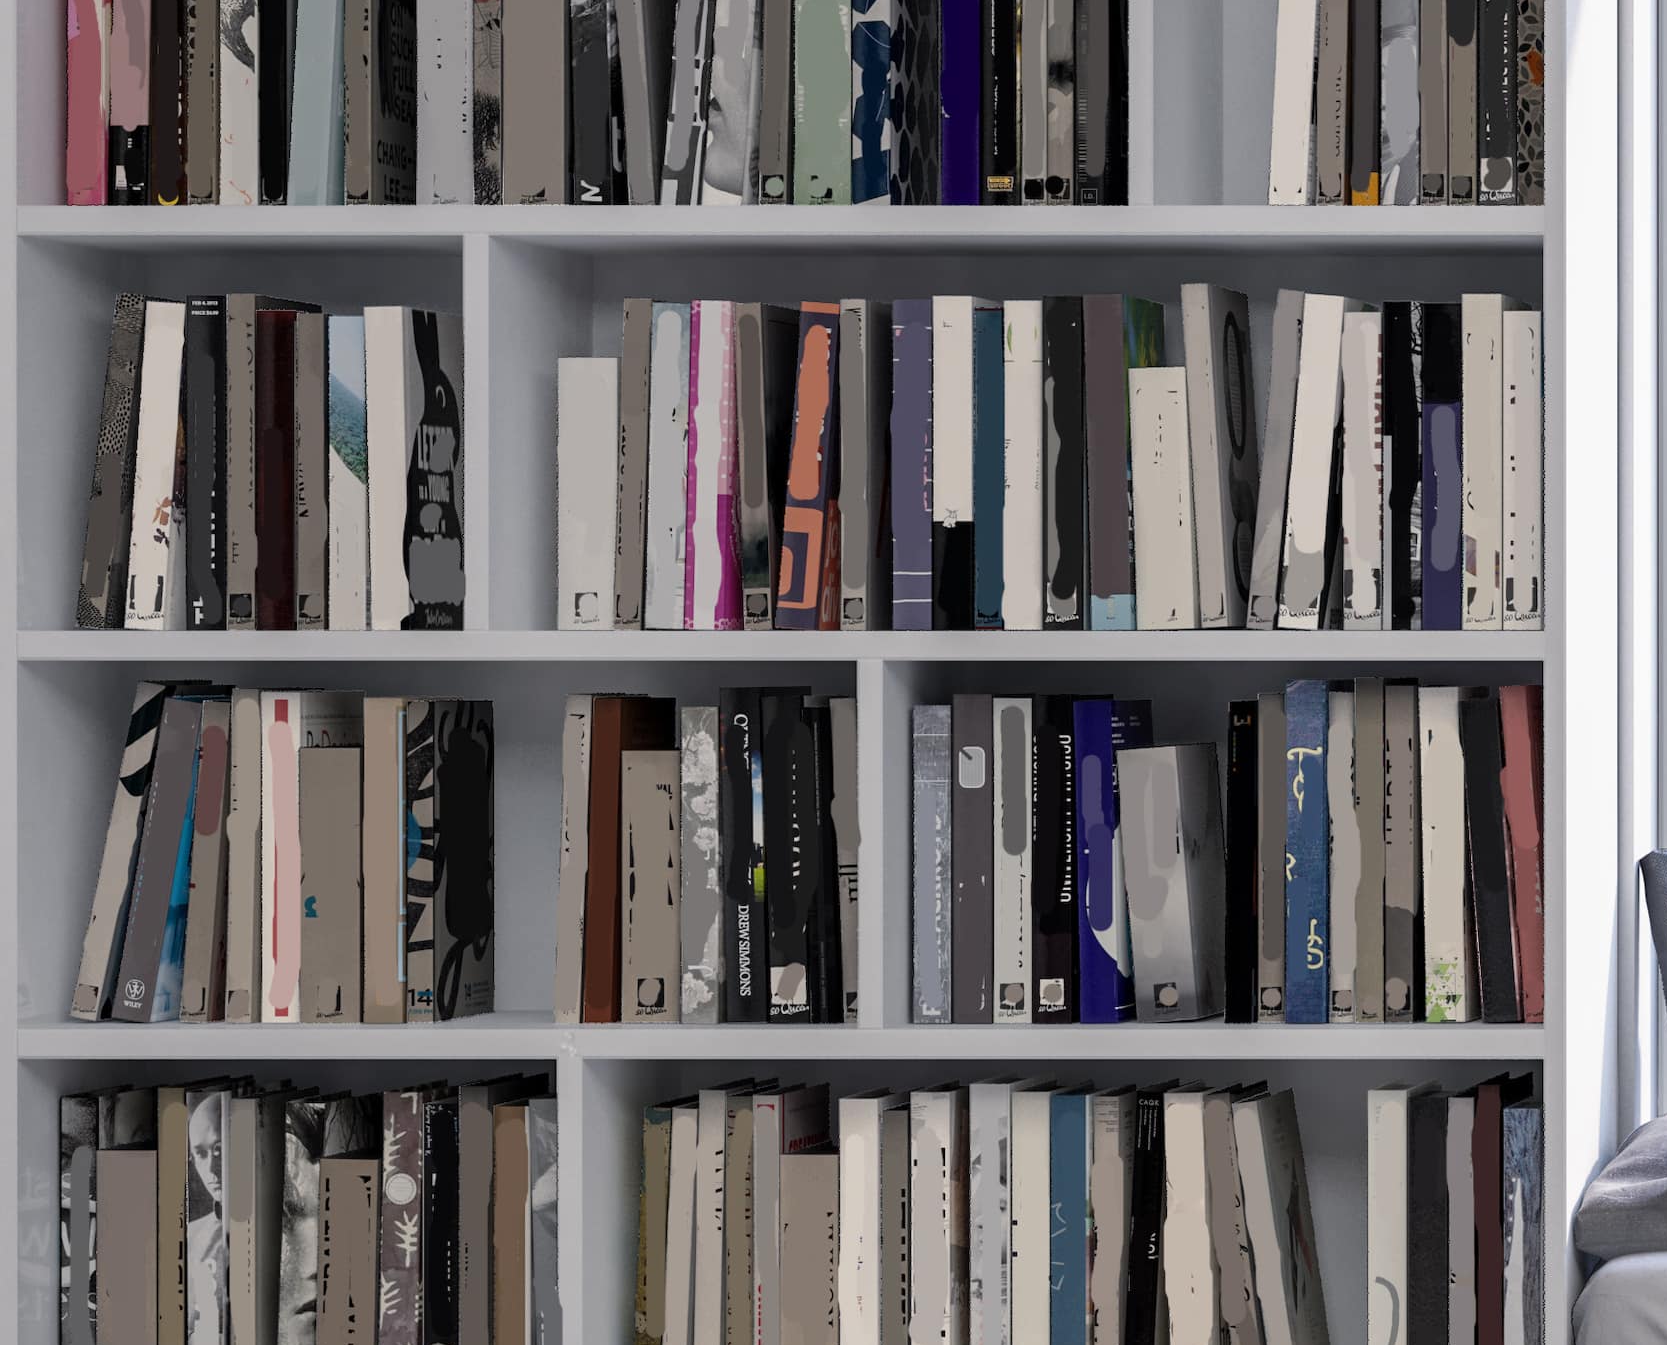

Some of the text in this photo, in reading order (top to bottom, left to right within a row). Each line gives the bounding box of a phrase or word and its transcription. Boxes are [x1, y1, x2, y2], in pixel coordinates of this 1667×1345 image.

[737, 904, 752, 996] DREW SIMMONS
[124, 1001, 143, 1009] WILEY
